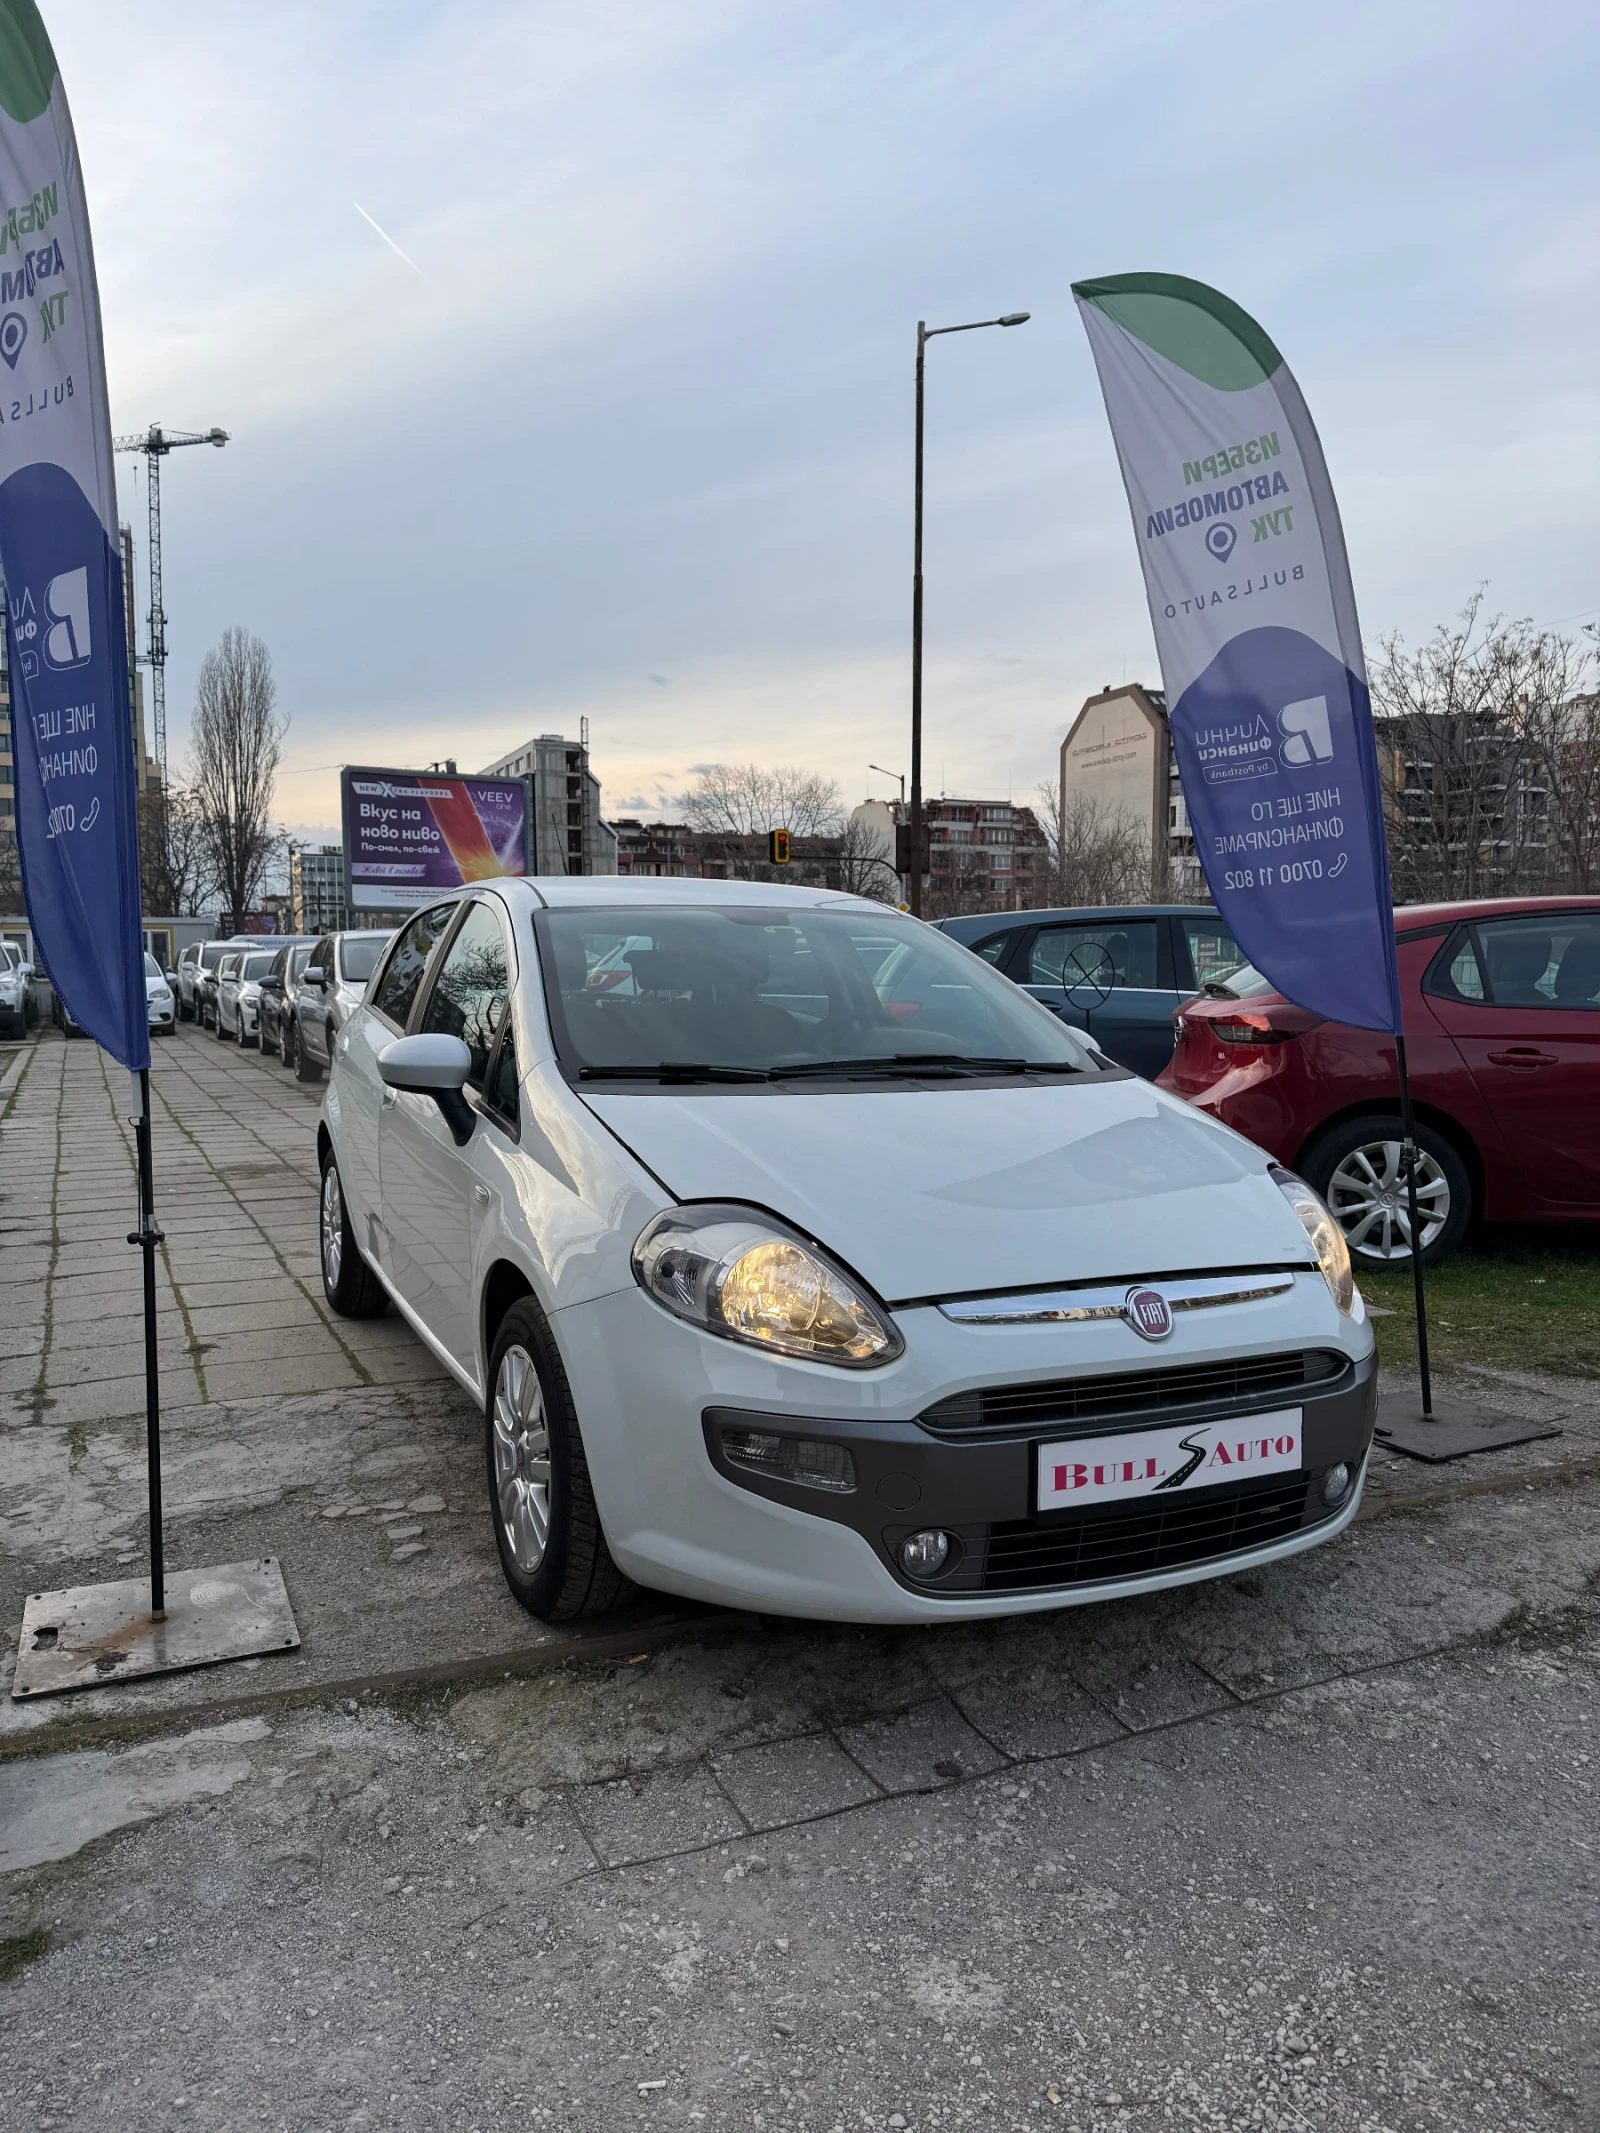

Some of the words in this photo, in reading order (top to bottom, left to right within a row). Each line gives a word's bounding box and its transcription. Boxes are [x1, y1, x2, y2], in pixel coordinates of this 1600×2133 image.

[411, 788, 449, 797] FLAVOURS
[477, 791, 513, 803] VEEV
[360, 803, 398, 822] Вкус
[401, 810, 421, 820] на
[495, 803, 512, 811] one
[361, 824, 399, 838] ново
[402, 826, 440, 840] ниво
[361, 842, 401, 854] По-смел,
[403, 845, 440, 854] по-свеж
[1139, 1302, 1166, 1326] FIAT
